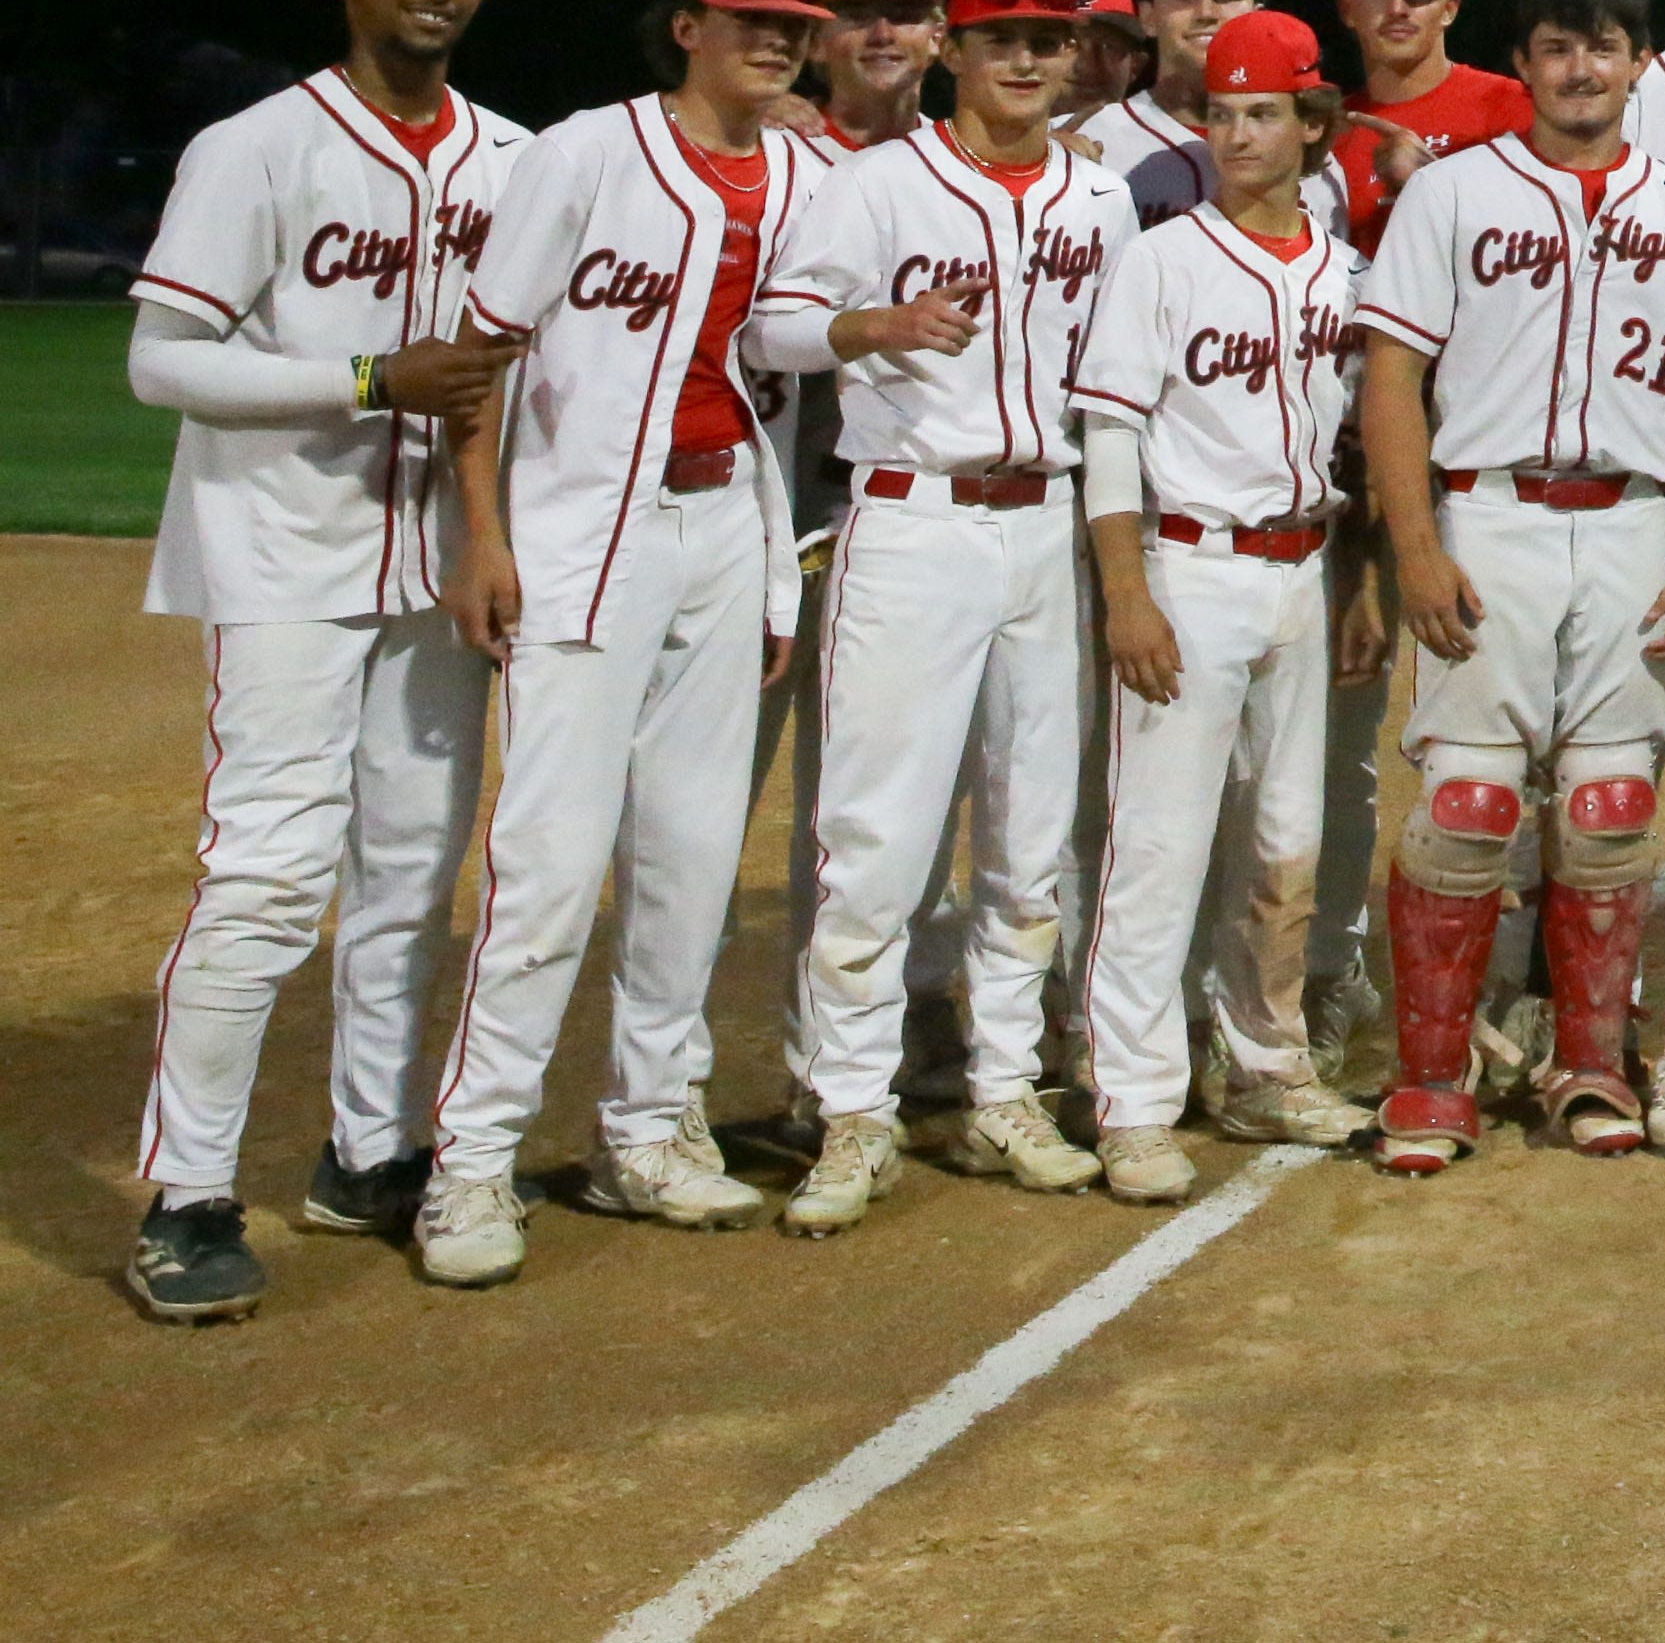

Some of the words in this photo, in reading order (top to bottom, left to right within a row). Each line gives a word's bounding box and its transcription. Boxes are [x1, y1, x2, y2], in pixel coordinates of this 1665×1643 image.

[303, 221, 408, 300] City
[568, 248, 676, 332] City
[1023, 226, 1104, 304] High
[1472, 228, 1567, 289] City
[1185, 327, 1276, 394] City
